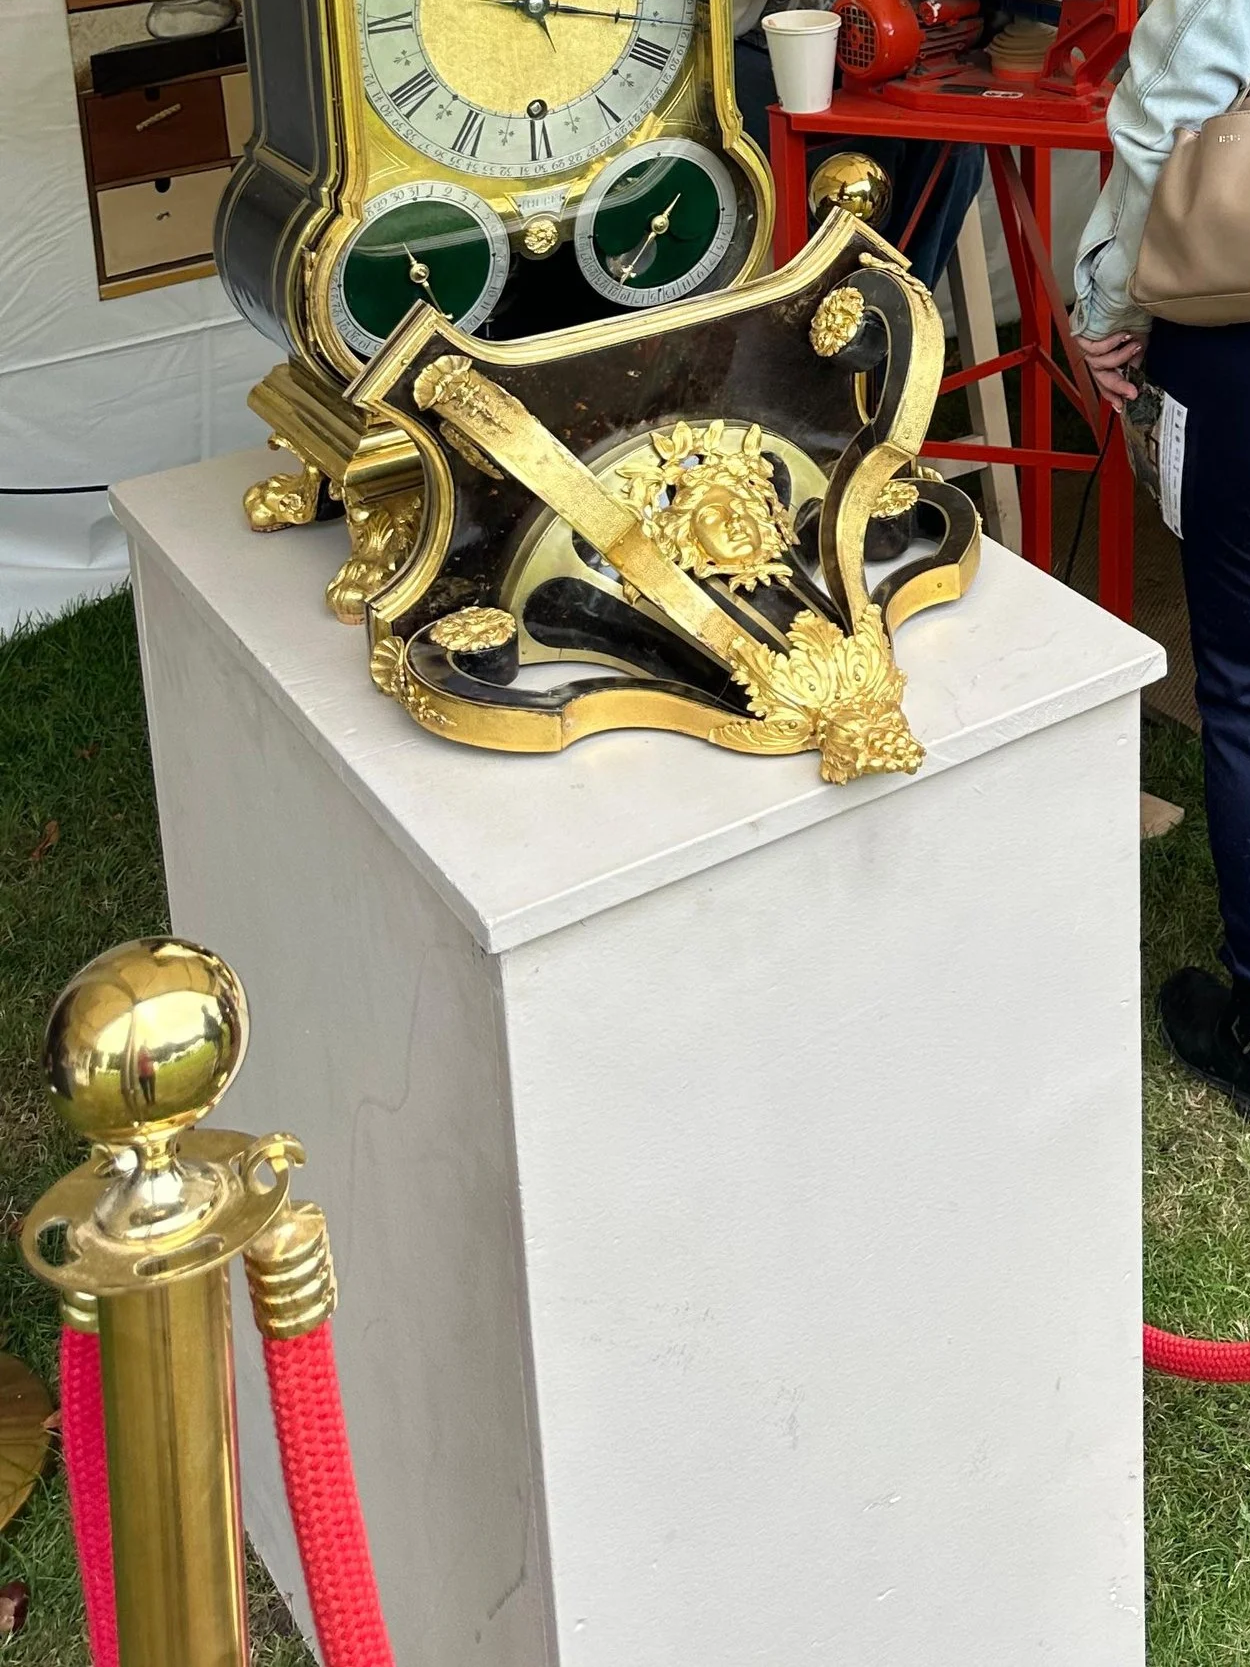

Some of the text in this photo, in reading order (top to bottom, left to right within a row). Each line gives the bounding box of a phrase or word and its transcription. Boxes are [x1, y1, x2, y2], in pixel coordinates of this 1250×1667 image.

[367, 10, 414, 38] IX
[629, 37, 672, 72] IIII
[676, 44, 686, 55] 19
[670, 58, 680, 70] 20
[661, 75, 672, 86] 21
[373, 91, 383, 103] 41
[388, 66, 440, 121] VIII
[650, 87, 663, 100] 22
[380, 104, 392, 119] 40
[392, 119, 405, 131] 39
[403, 129, 417, 143] 38
[450, 110, 486, 158] VII
[527, 119, 552, 161] VI
[600, 136, 613, 148] 26
[418, 142, 432, 153] 37
[586, 144, 600, 157] 27
[435, 149, 445, 161] 36
[568, 154, 583, 166] 28
[449, 157, 461, 168] 35
[466, 163, 478, 173] 34
[552, 160, 565, 170] 29
[483, 166, 495, 175] 33
[500, 166, 513, 176] 32
[519, 166, 531, 175] 31
[534, 165, 547, 174] 30
[390, 190, 404, 201] 30
[408, 186, 419, 196] 31
[444, 187, 452, 196] 2
[460, 191, 468, 201] 3
[374, 198, 387, 211] 29
[472, 199, 480, 210] 4
[682, 280, 689, 290] 11
[488, 286, 499, 297] 10
[481, 302, 491, 310] 11
[468, 314, 481, 326] 12
